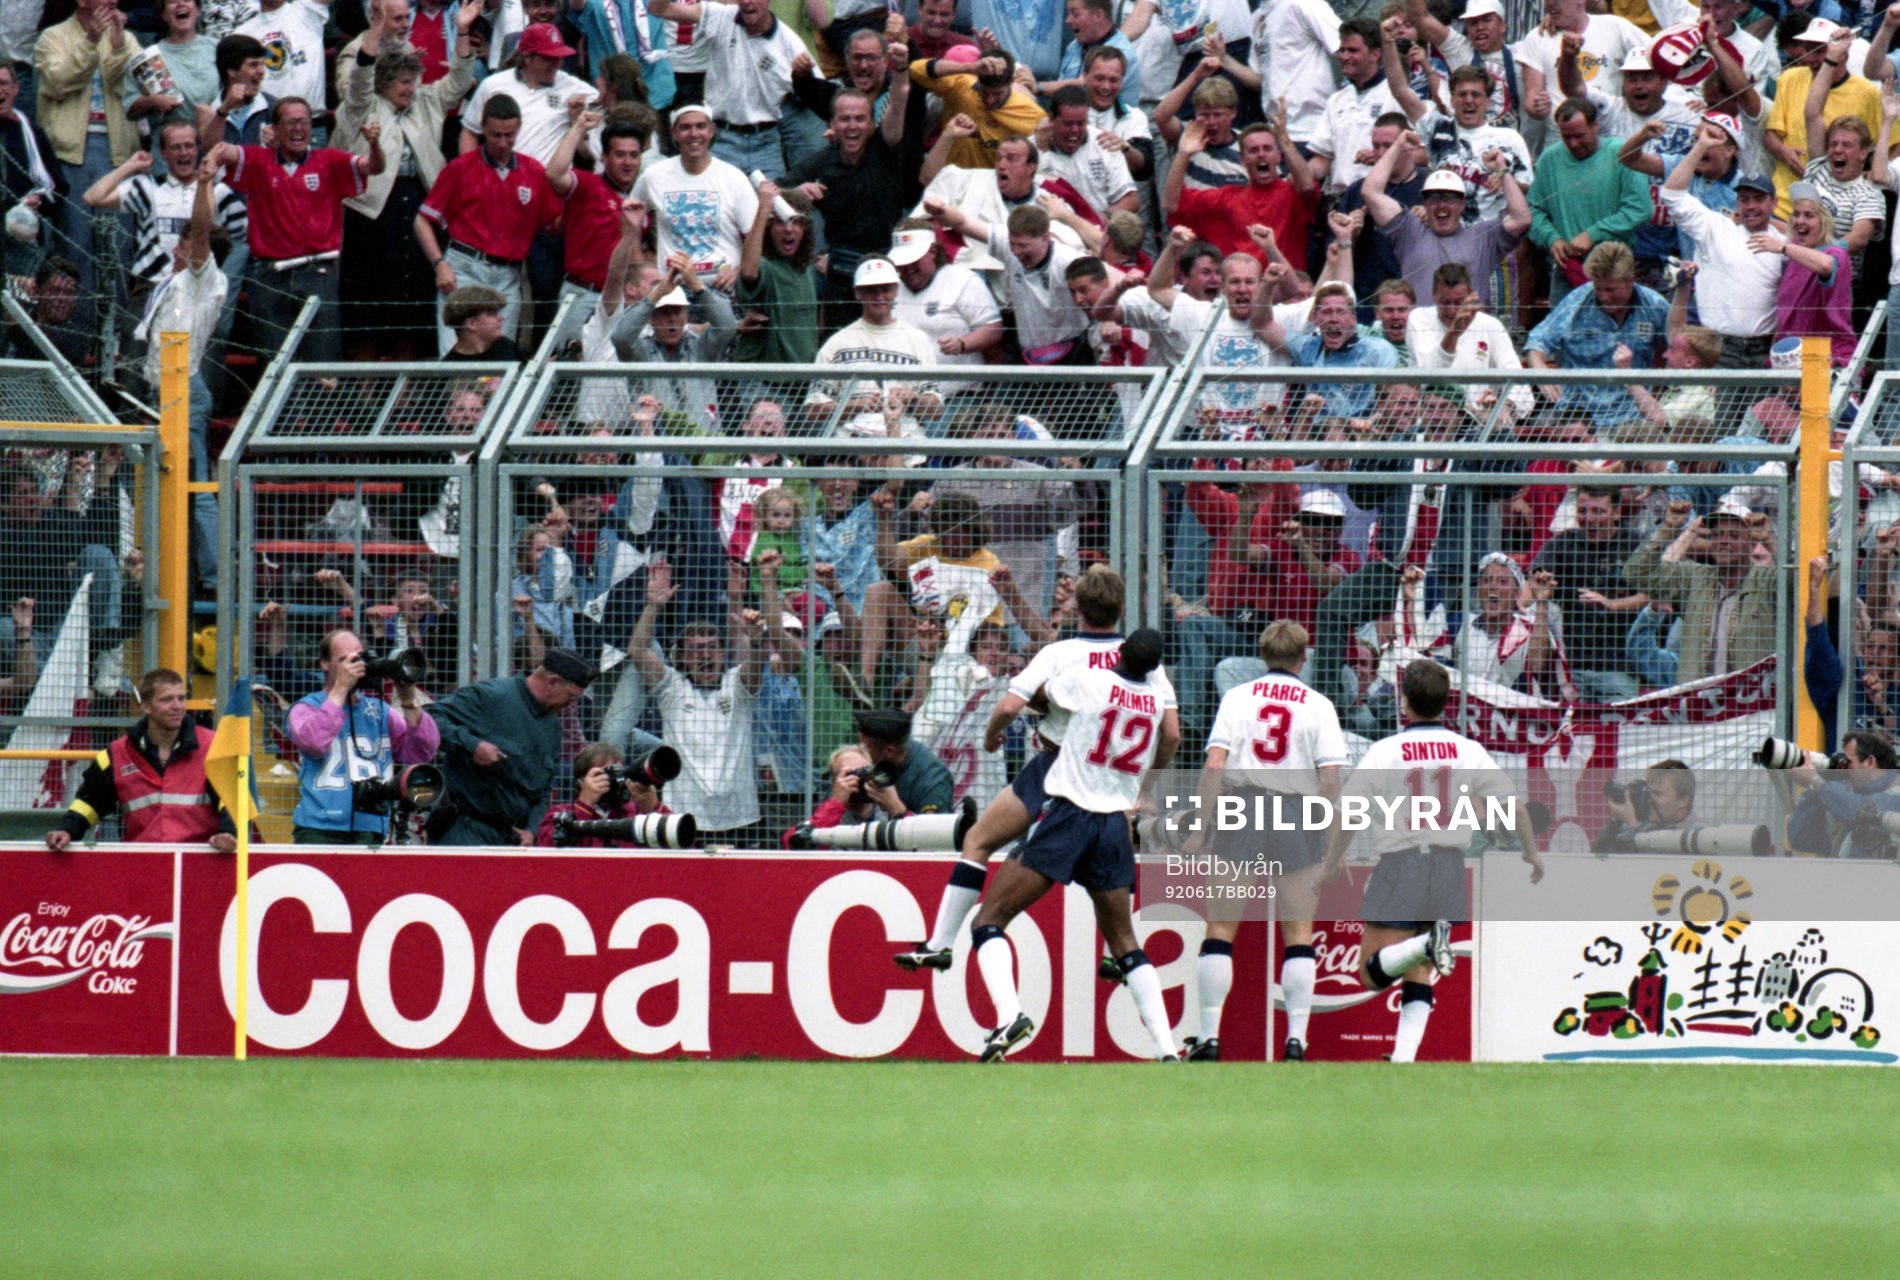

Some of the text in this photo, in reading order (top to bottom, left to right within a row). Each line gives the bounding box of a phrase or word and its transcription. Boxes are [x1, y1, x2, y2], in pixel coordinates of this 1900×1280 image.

[1109, 685, 1157, 714] PALMER
[1252, 682, 1308, 704] PEARCE
[1085, 706, 1154, 776] 12
[1252, 703, 1294, 764] 3
[1401, 741, 1459, 762] SINTON
[37, 902, 71, 917] Enjoy
[1333, 919, 1366, 935] Enjoy
[0, 912, 151, 969] Coca-Cola
[219, 862, 1209, 1059] Coca-Cola
[88, 971, 138, 995] Coke
